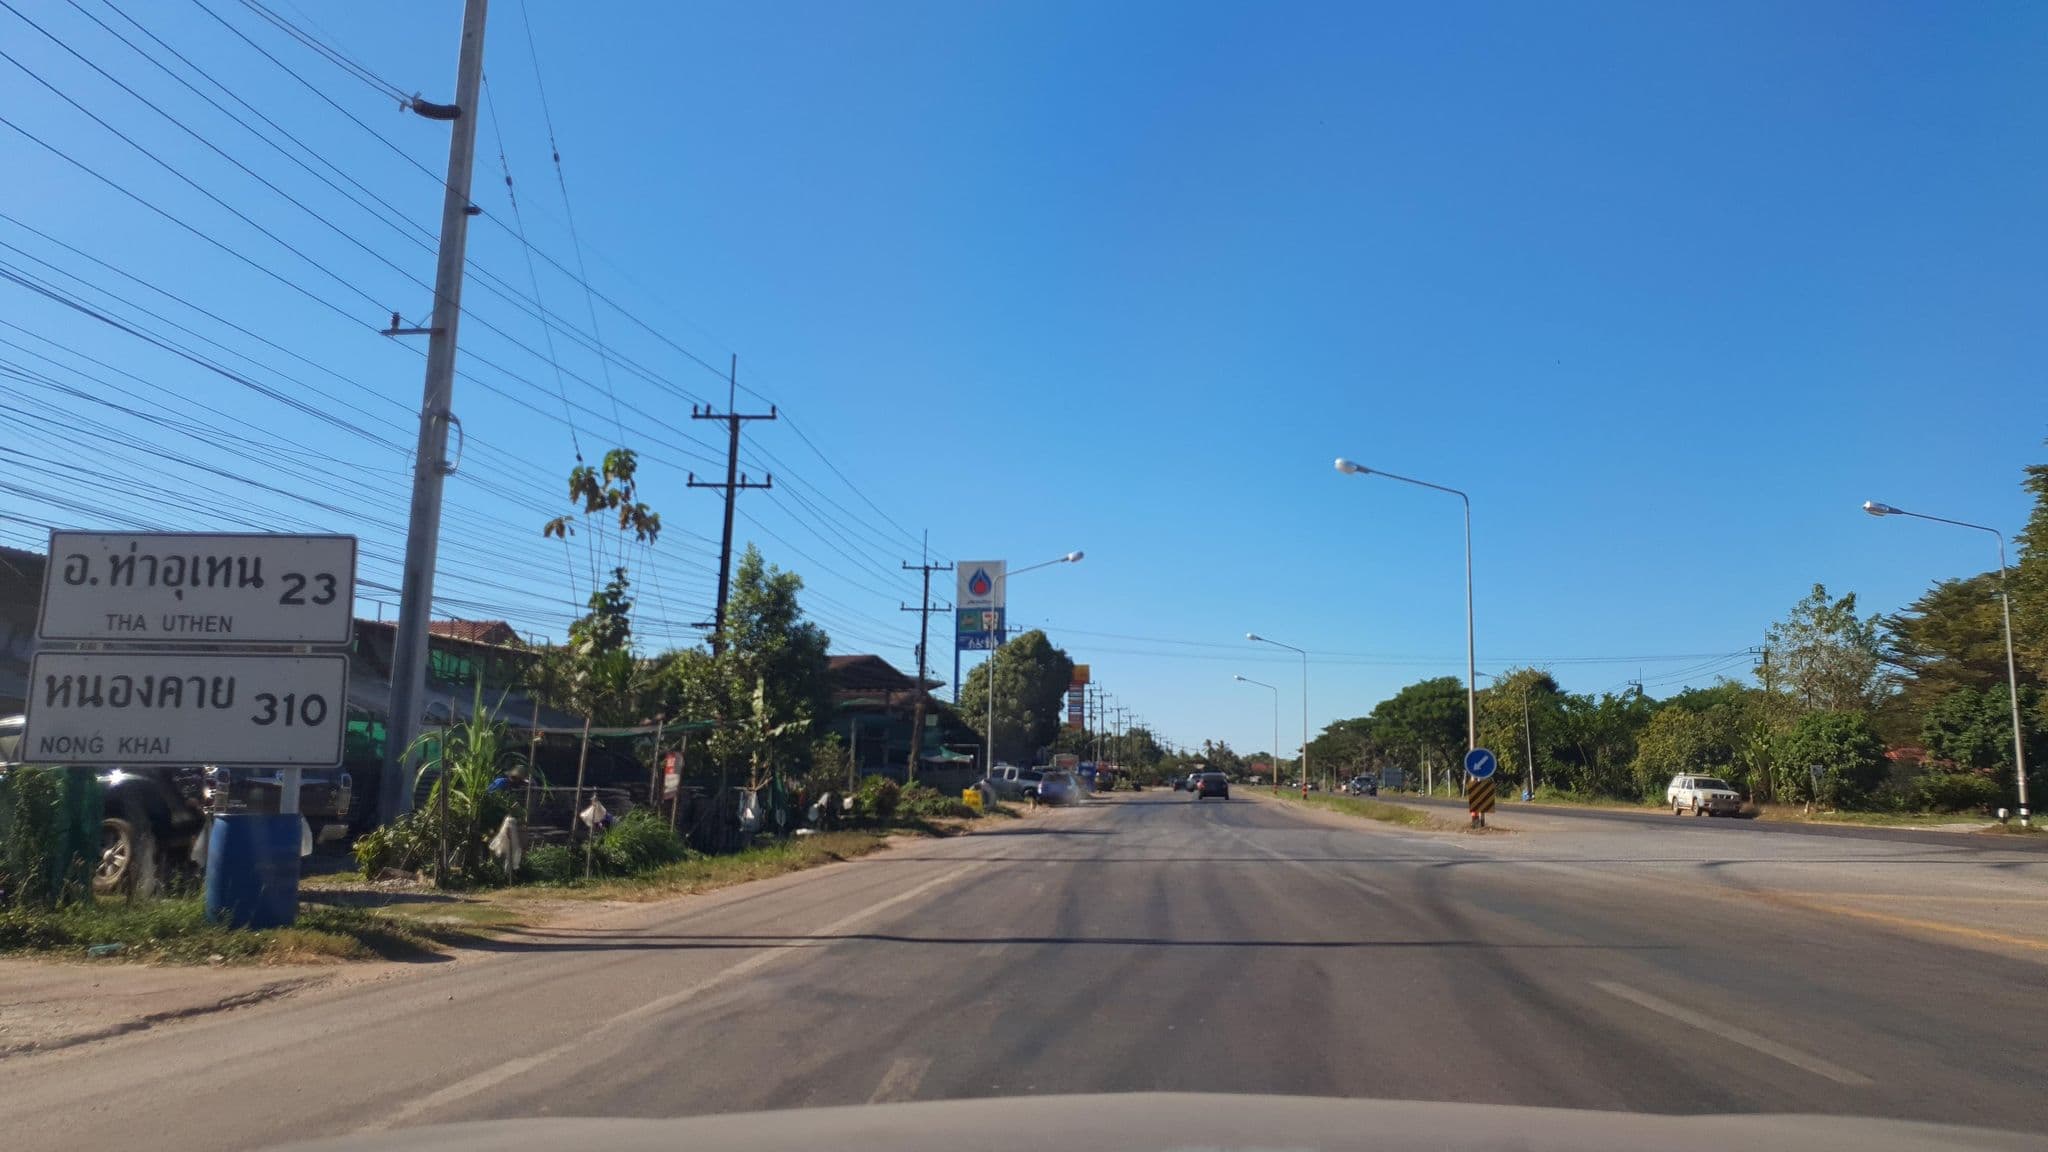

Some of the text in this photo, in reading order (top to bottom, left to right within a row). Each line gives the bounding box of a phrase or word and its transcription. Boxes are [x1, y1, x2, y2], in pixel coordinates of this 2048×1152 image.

[279, 573, 337, 605] 23
[105, 614, 233, 633] THA UTHEN
[45, 674, 328, 727] หนองคาย 310
[40, 737, 171, 754] NONG KHAI
